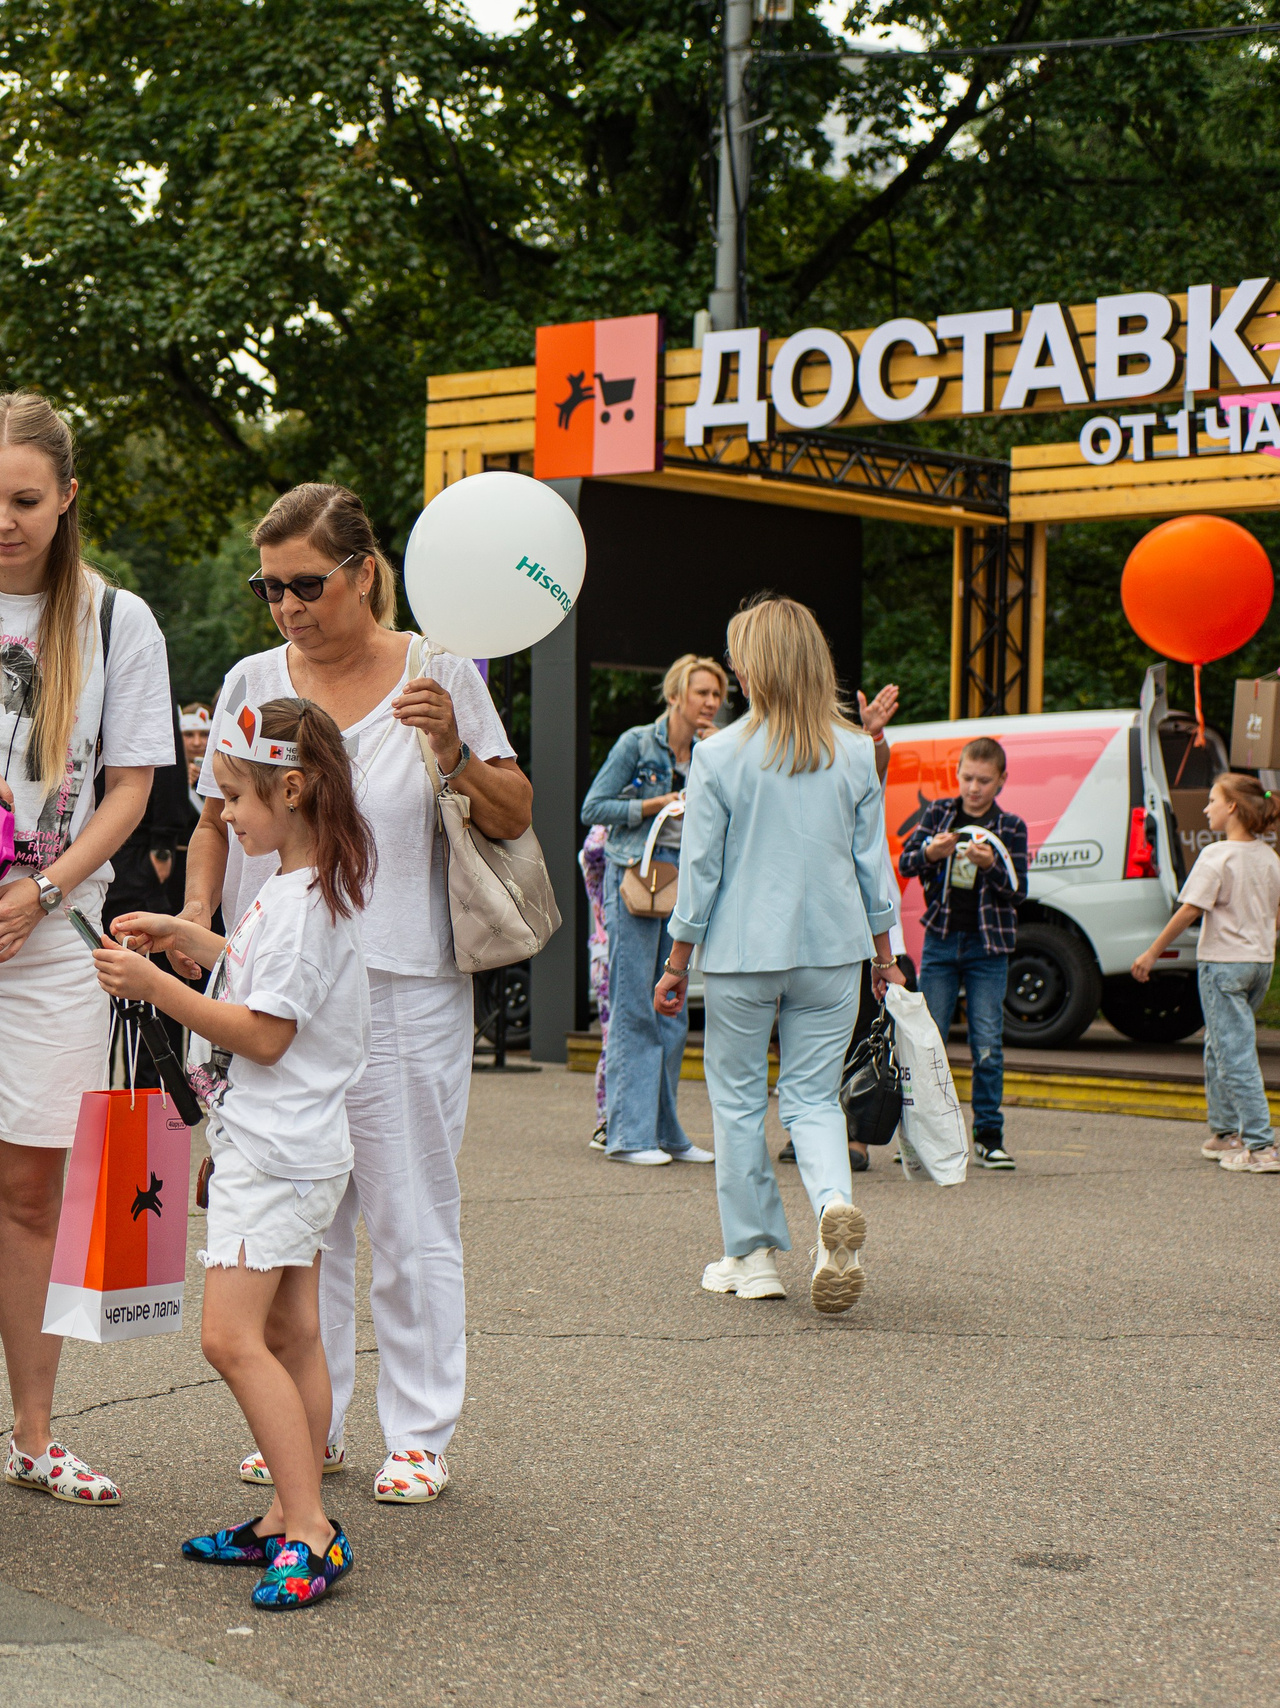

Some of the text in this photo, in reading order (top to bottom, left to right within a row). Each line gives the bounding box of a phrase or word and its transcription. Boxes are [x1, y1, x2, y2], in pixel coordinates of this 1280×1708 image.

[685, 277, 1280, 446] ДОСТАВК
[1080, 412, 1157, 464] ОТ
[1166, 408, 1190, 458] 1
[14, 829, 61, 843] REATING
[15, 850, 44, 865] MAKE
[105, 1299, 180, 1325] четыре лапы
